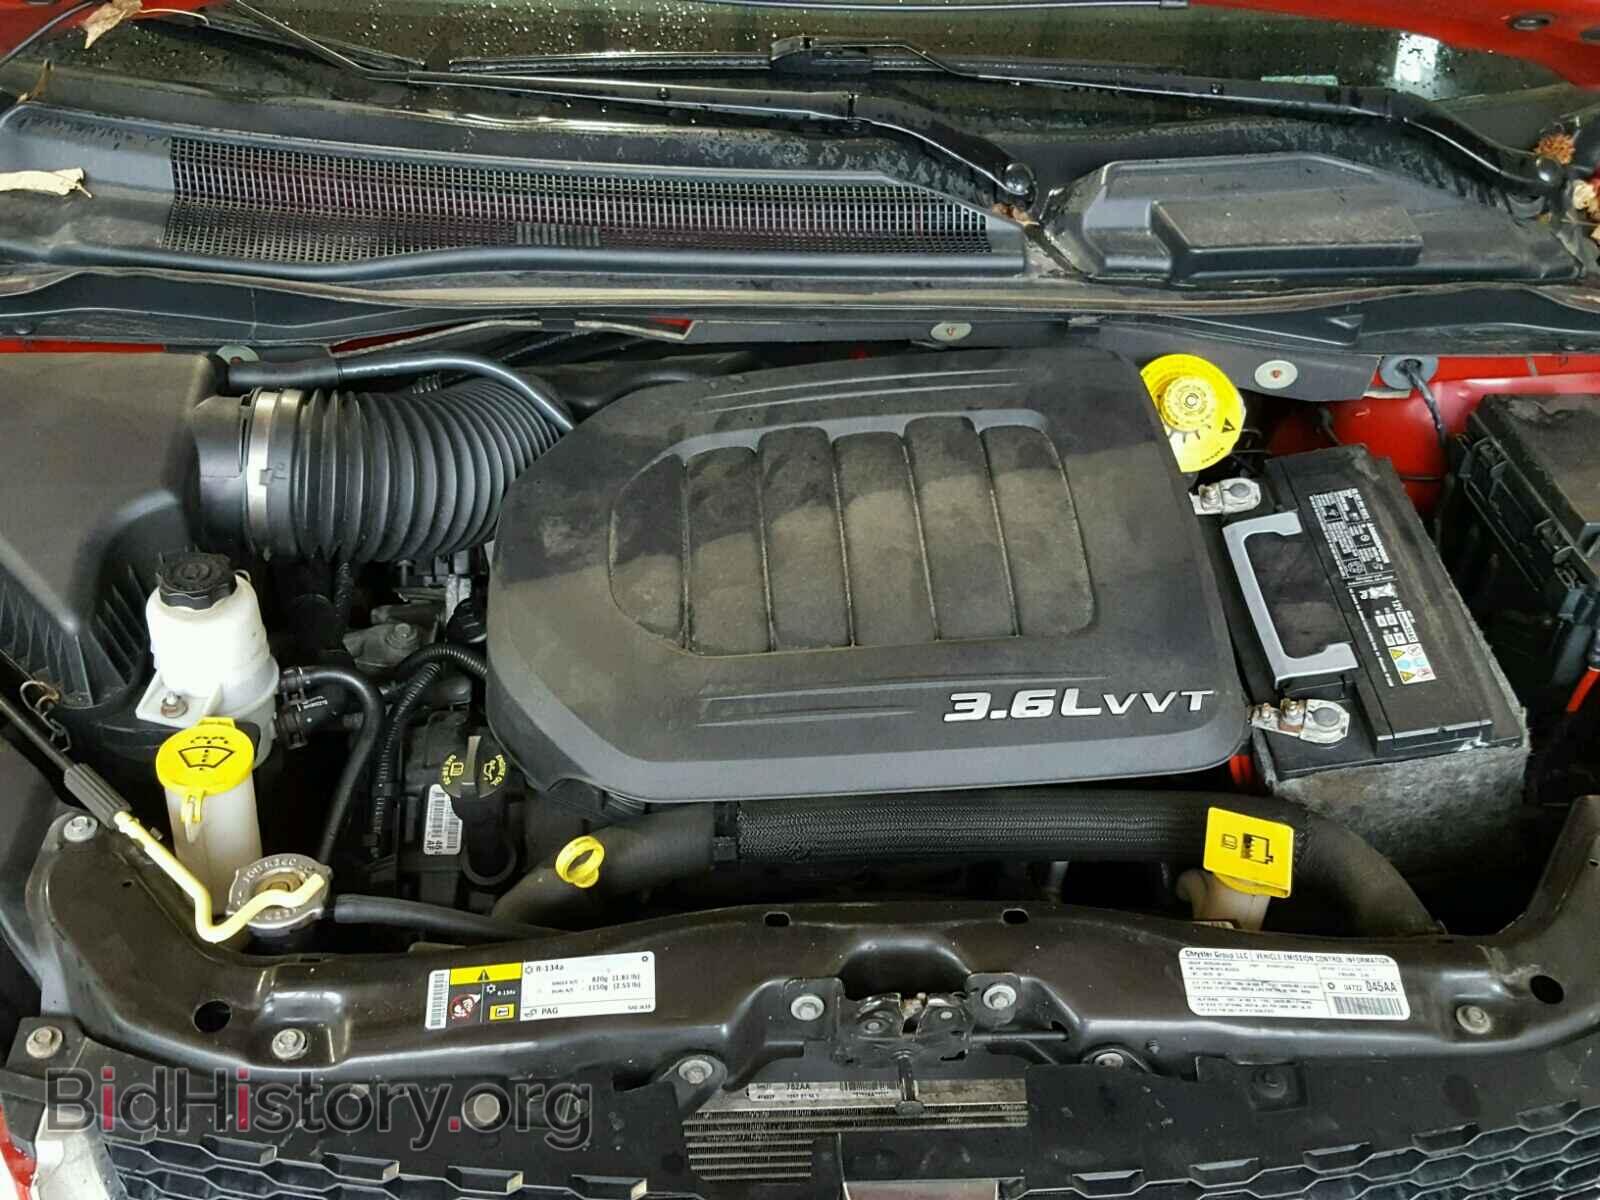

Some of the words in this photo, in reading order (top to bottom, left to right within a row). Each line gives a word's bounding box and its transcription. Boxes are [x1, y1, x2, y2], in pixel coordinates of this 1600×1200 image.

[943, 688, 1102, 723] 3.6L
[1185, 949, 1213, 959] Chrysler
[1214, 951, 1234, 960] Group
[1256, 953, 1281, 961] VEHICLE
[1283, 954, 1313, 962] EMISSION
[1315, 955, 1344, 963] CONTROL
[1346, 956, 1390, 964] INFORMATION
[541, 1006, 559, 1016] PAG
